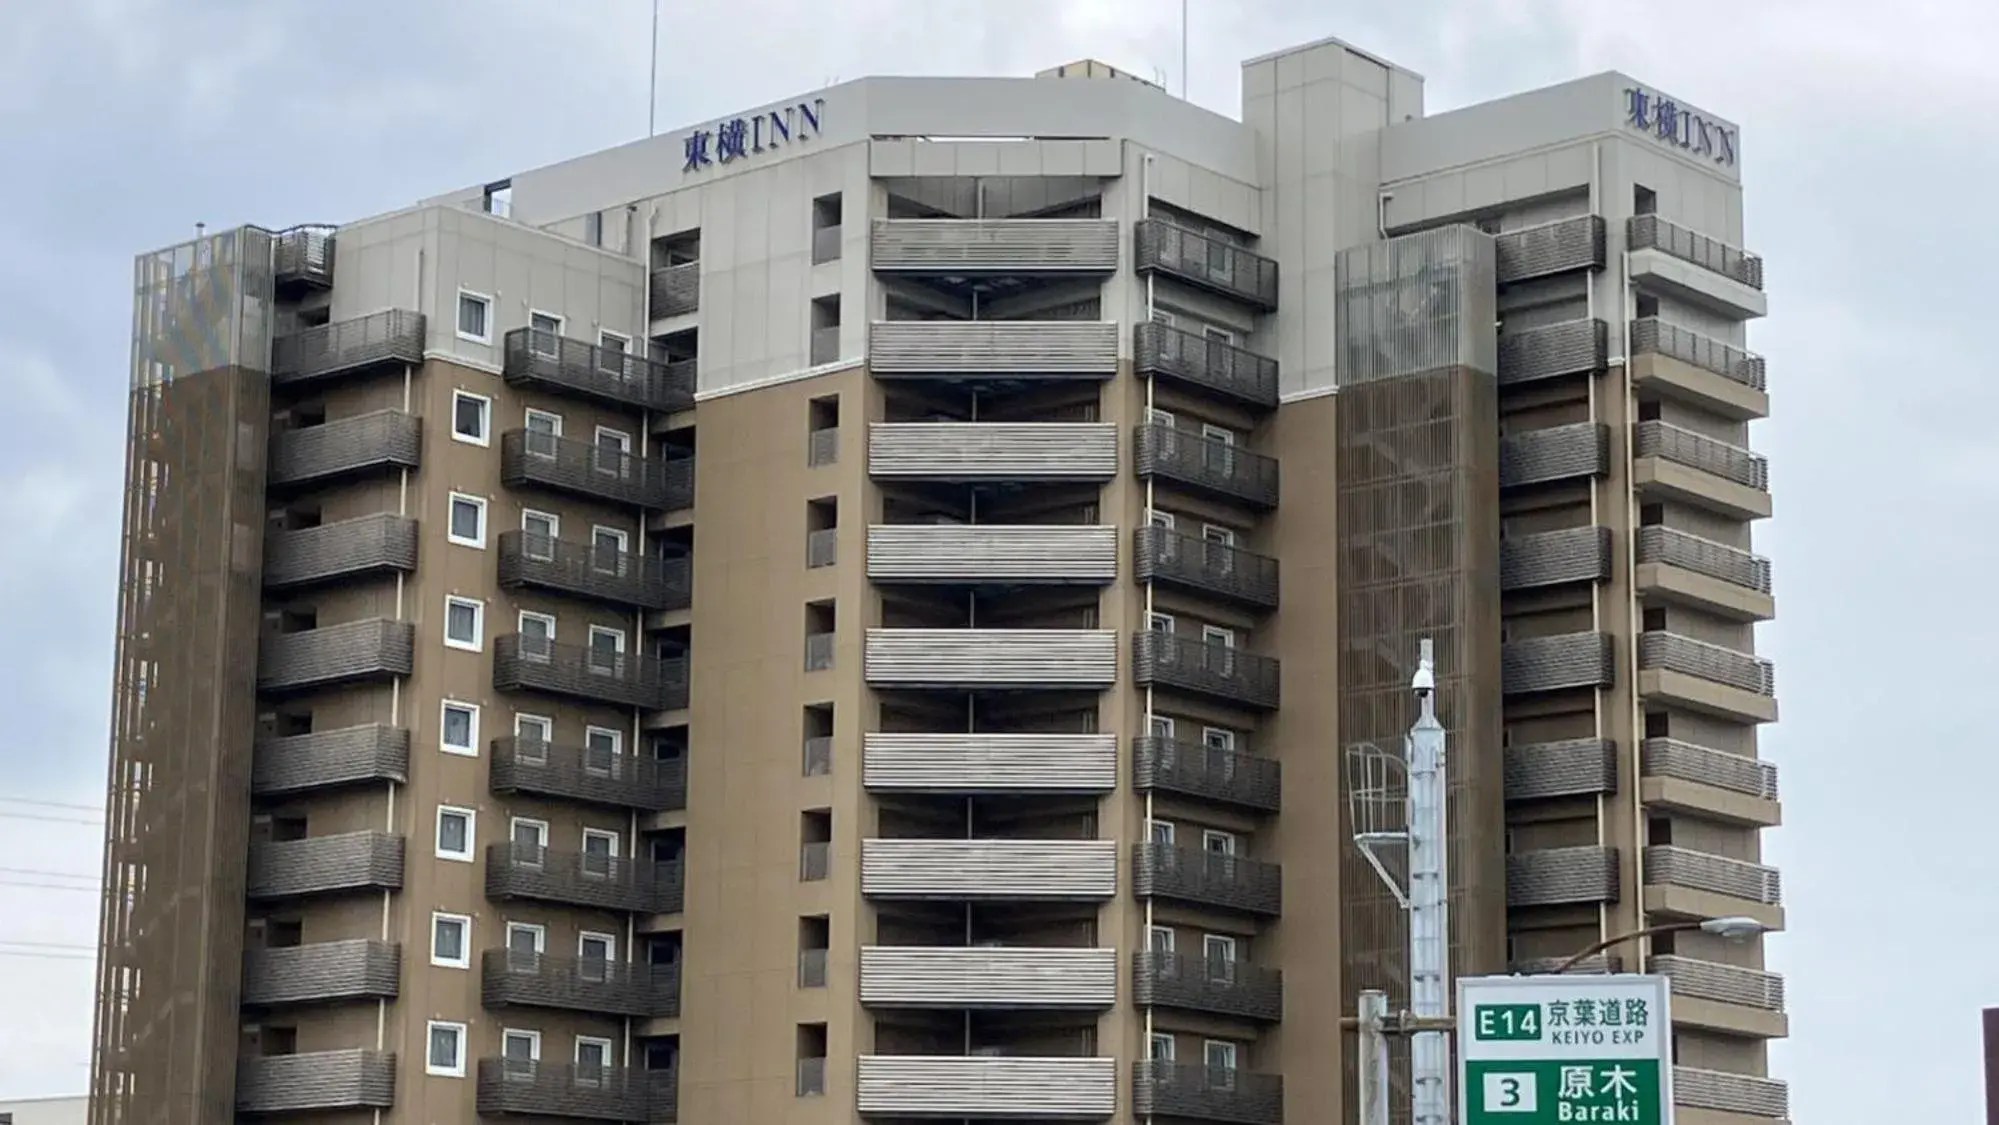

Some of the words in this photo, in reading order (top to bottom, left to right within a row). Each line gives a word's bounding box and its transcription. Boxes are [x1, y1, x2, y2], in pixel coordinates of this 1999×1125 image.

[682, 98, 825, 173] 東横INN
[1480, 1010, 1538, 1035] E14
[1548, 998, 1648, 1026] 京葉道路
[1552, 1031, 1604, 1045] KEIYO
[1612, 1030, 1644, 1044] EXP
[1500, 1078, 1520, 1107] 3
[1558, 1064, 1637, 1099] 原木
[1558, 1101, 1639, 1122] Baraki
